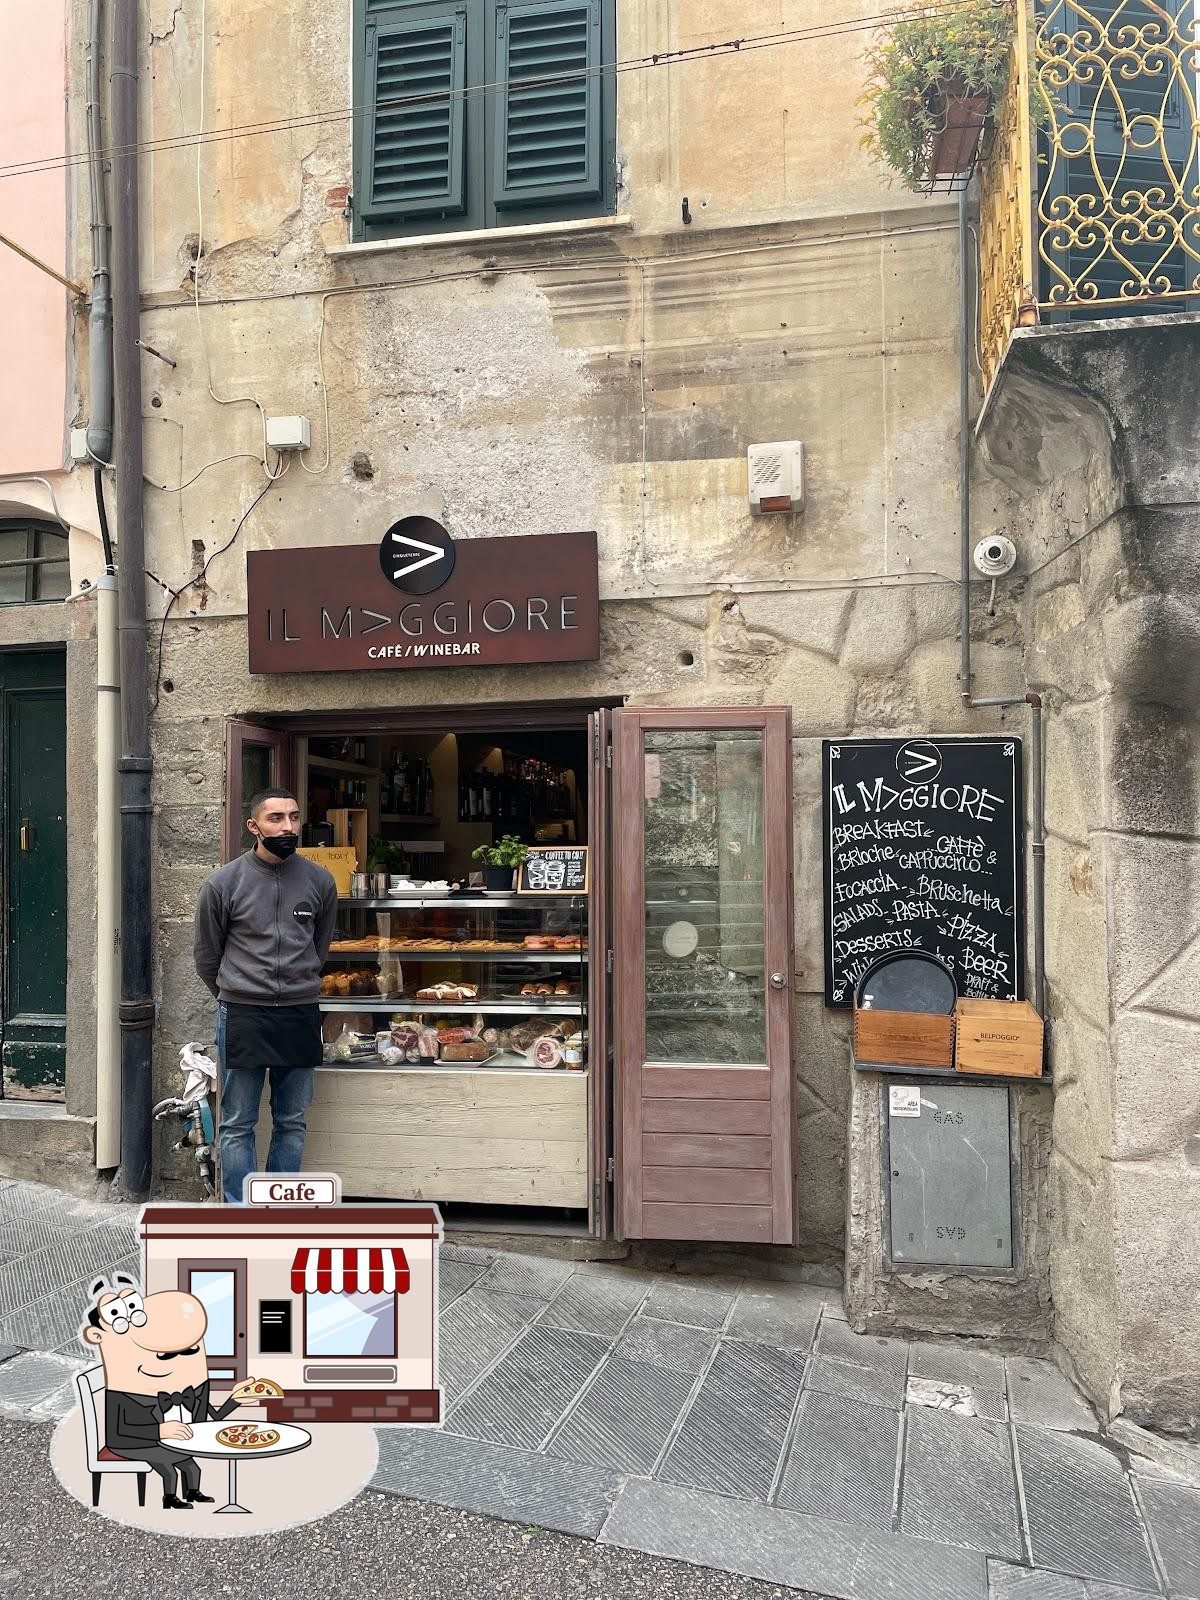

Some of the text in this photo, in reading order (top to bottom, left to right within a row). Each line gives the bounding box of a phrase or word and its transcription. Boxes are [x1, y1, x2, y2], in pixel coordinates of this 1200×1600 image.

[266, 608, 301, 642] IL
[833, 783, 857, 815] IL
[833, 898, 884, 933] SALADS
[891, 899, 942, 922] PASTA
[933, 1110, 965, 1125] GAS
